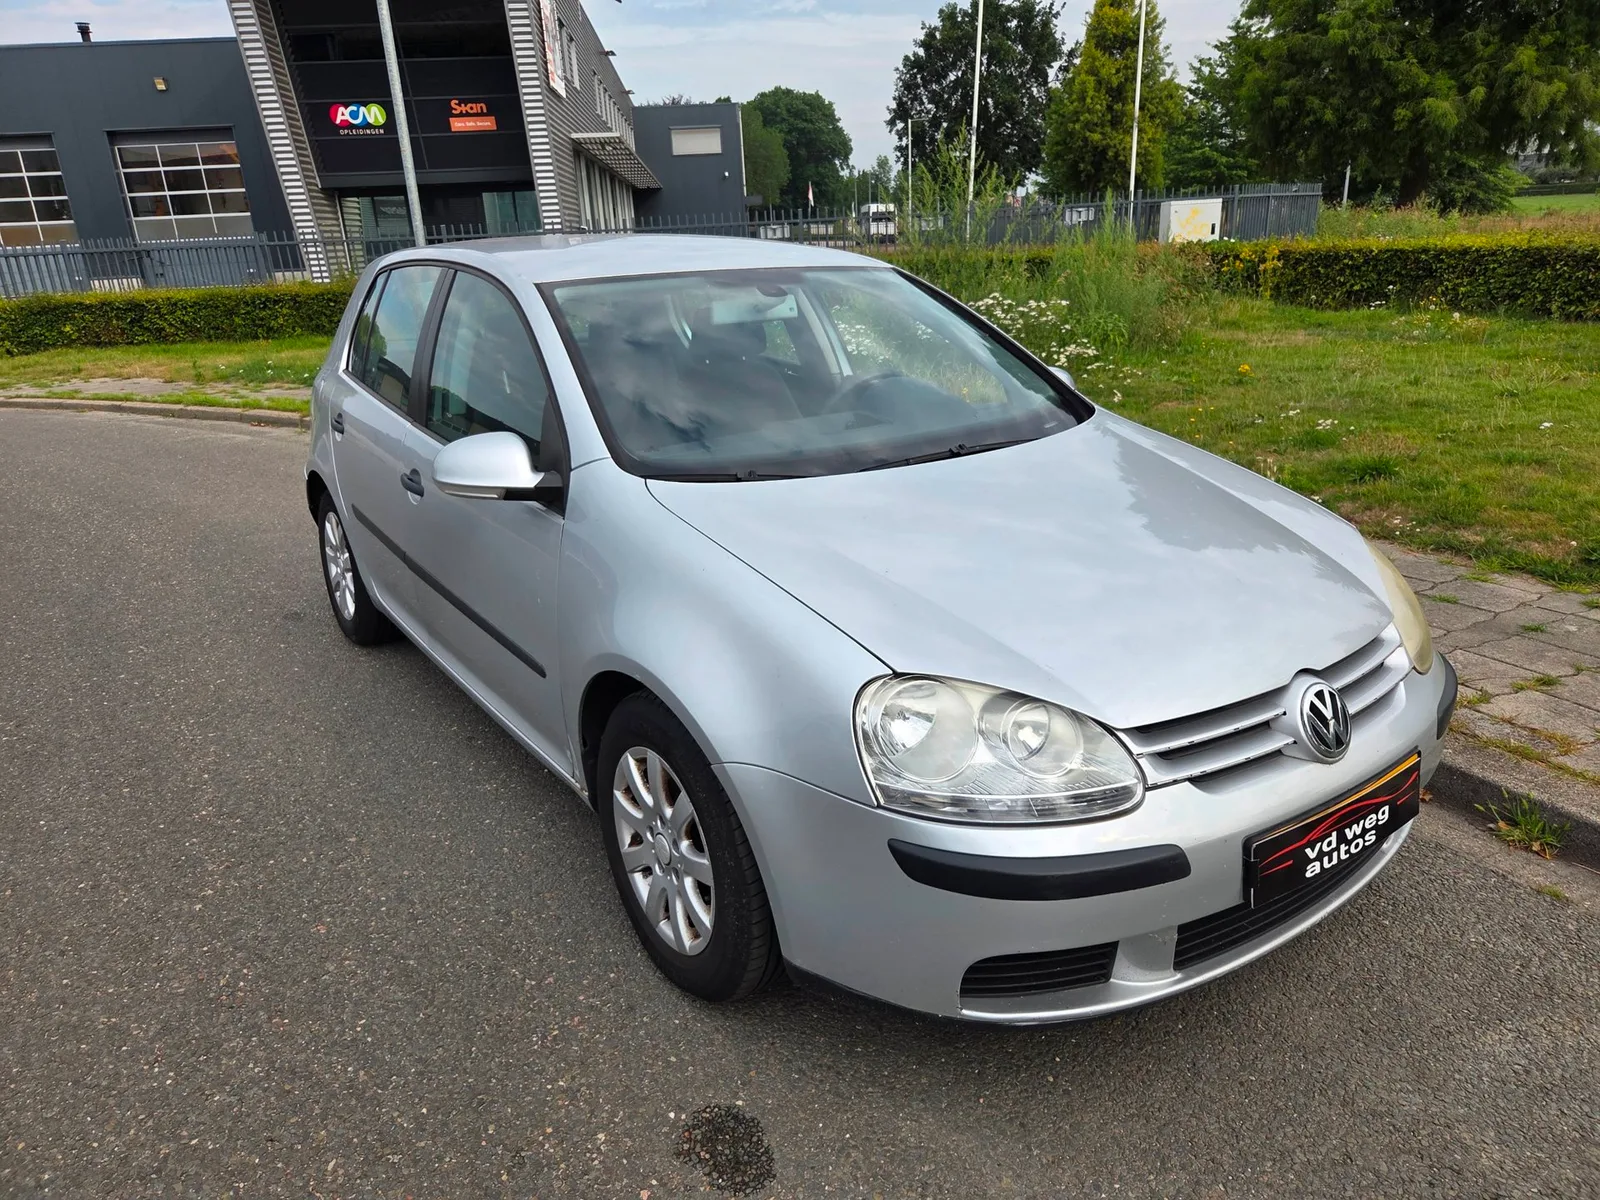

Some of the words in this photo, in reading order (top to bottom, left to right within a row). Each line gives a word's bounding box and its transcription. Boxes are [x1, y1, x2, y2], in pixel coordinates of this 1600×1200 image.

[334, 105, 385, 125] ACM
[1304, 830, 1337, 859] vd
[1344, 805, 1389, 840] weg
[1305, 830, 1376, 878] autos
